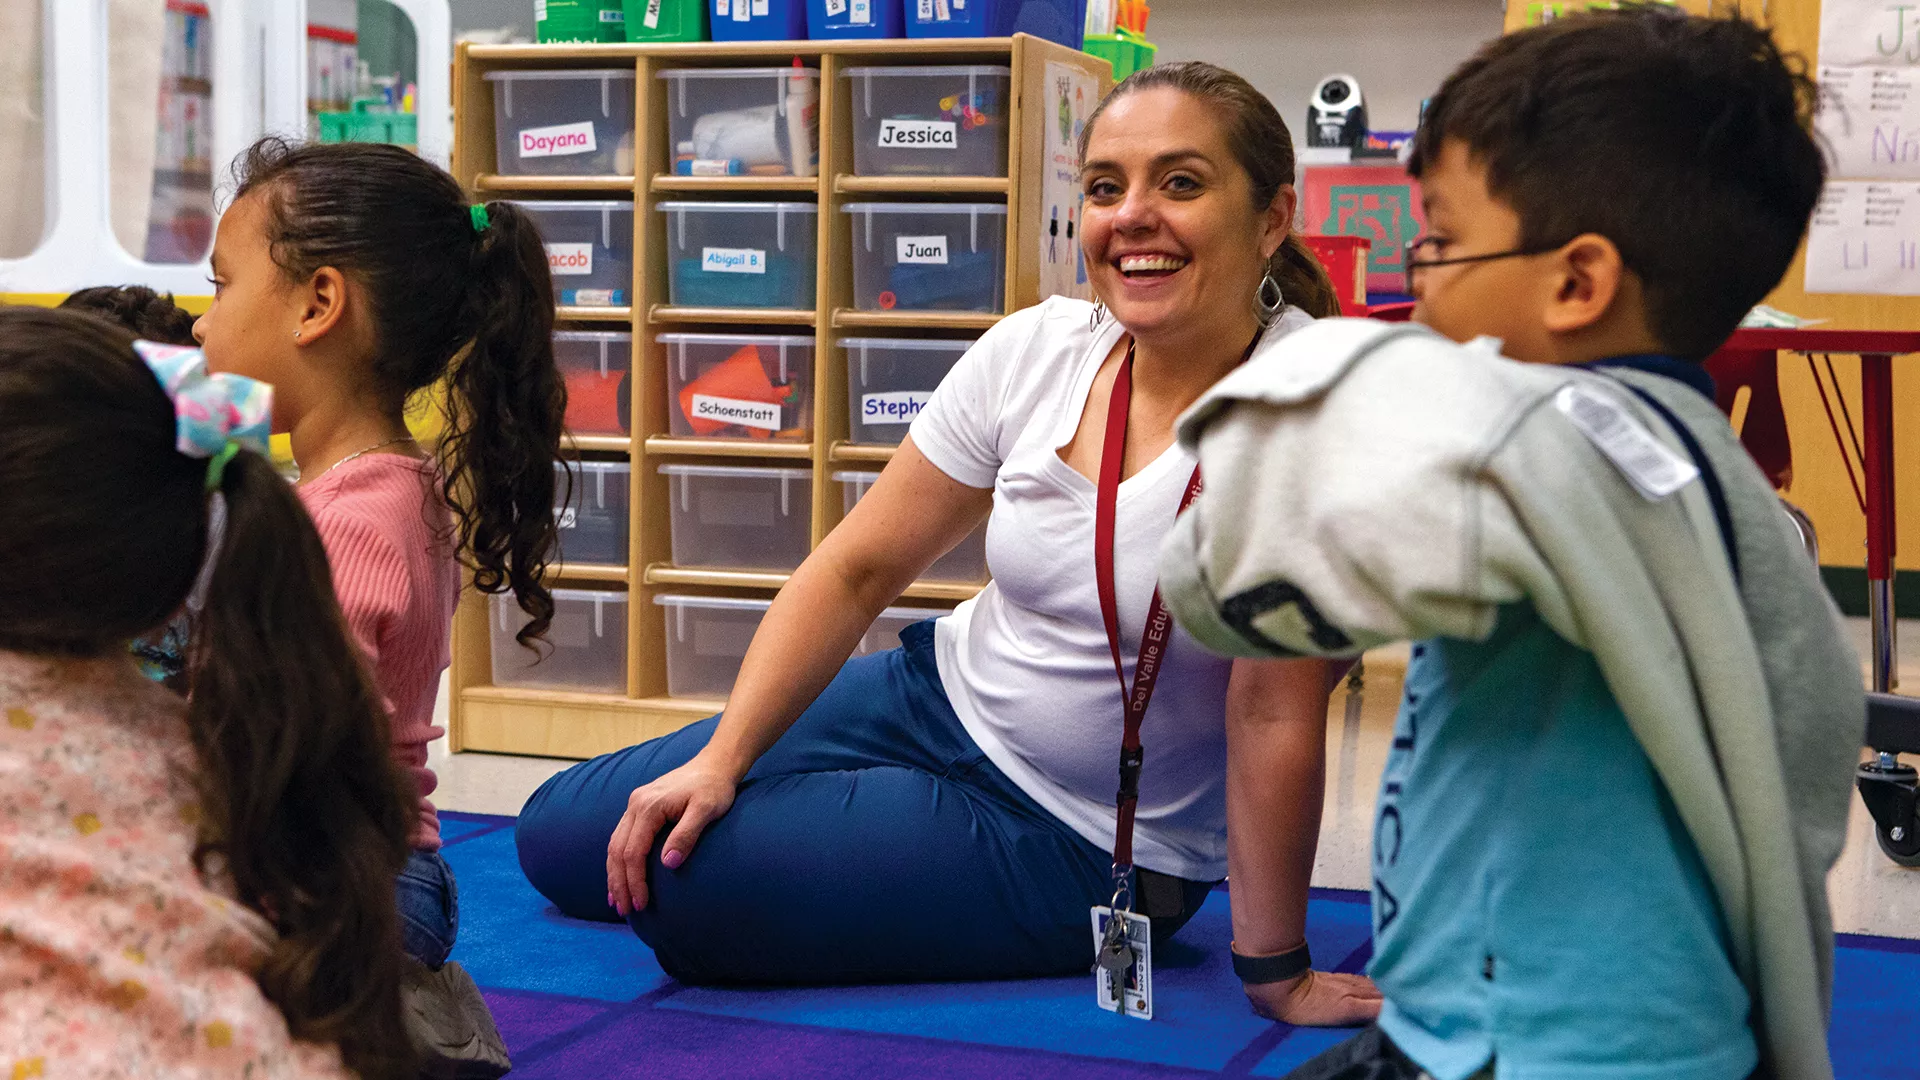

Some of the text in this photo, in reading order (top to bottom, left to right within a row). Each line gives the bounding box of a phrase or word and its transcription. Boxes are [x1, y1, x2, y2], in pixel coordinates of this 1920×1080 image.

[523, 133, 587, 153] Dayana
[883, 126, 953, 144] Jessica
[549, 250, 588, 267] acob
[707, 252, 745, 267] Abigail
[905, 243, 942, 258] Juan
[699, 402, 774, 421] Schoenstatt
[1148, 601, 1168, 642] Educ
[1138, 645, 1159, 682] Valle
[1132, 686, 1147, 712] Del
